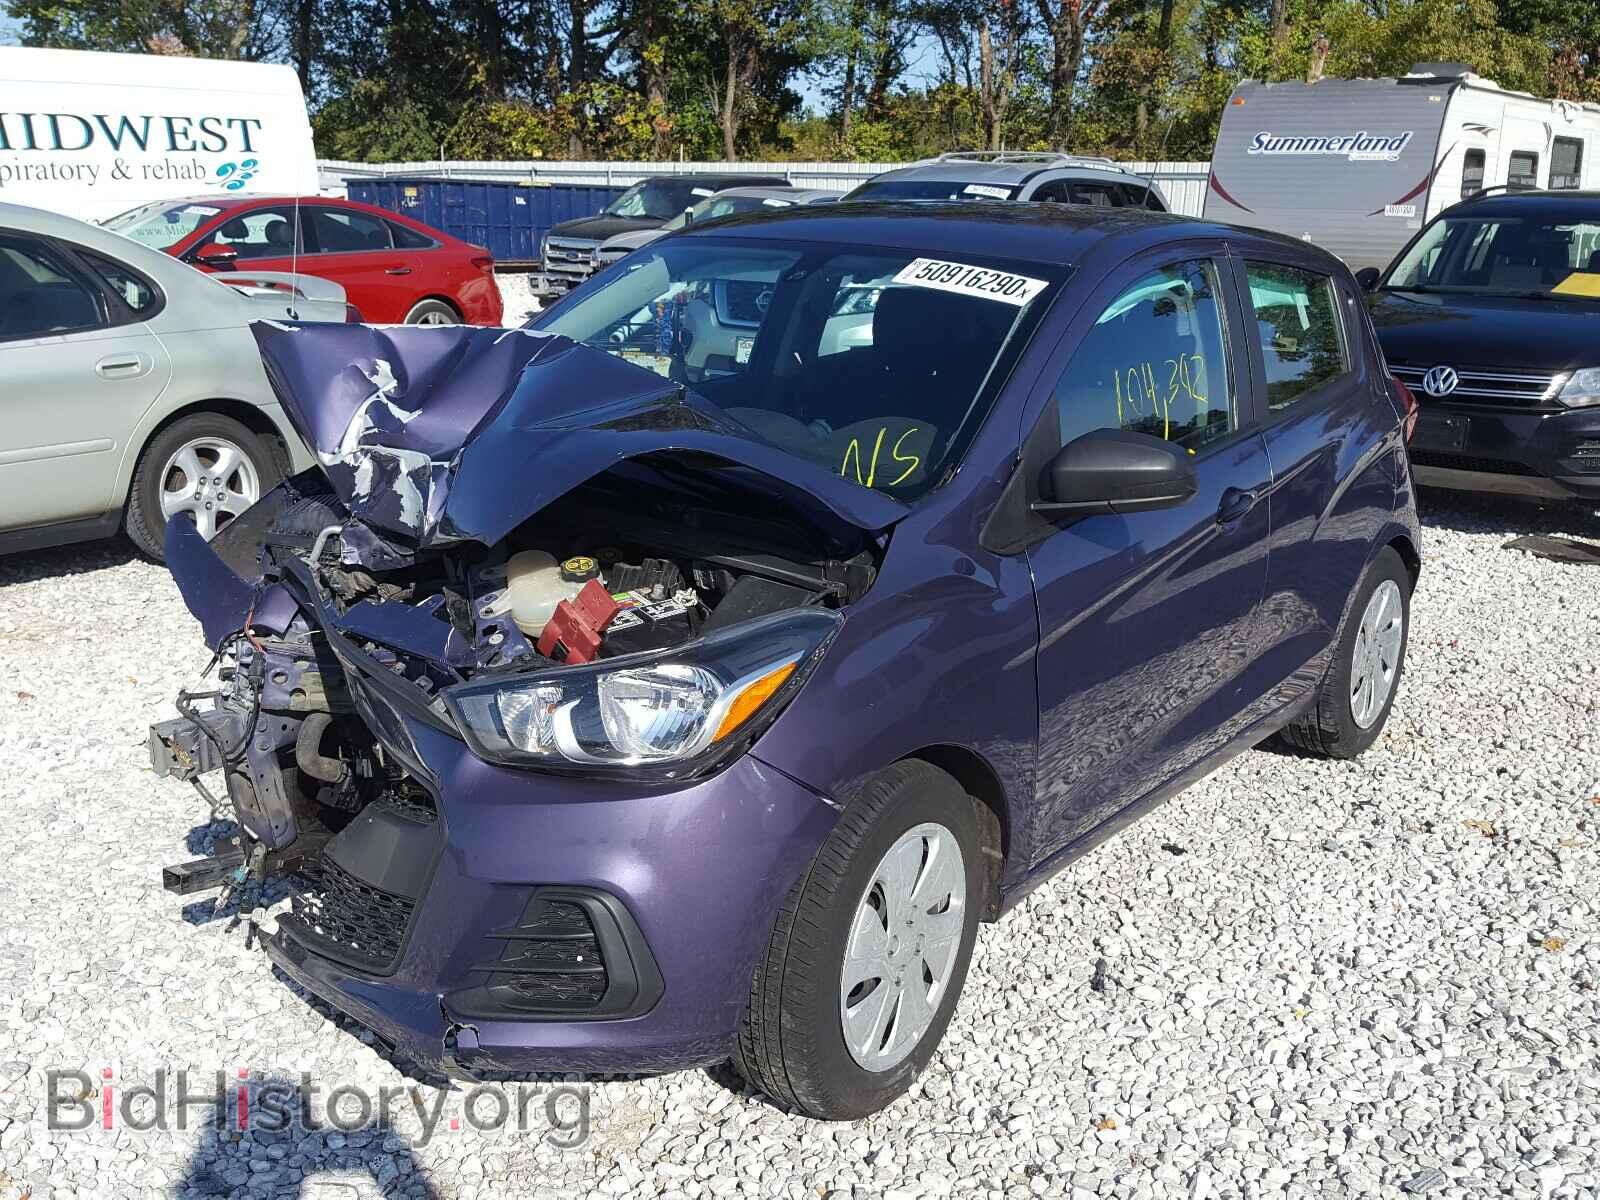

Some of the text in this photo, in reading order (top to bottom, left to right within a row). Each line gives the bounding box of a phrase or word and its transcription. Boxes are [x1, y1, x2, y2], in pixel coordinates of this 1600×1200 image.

[1249, 131, 1412, 152] Summerland
[111, 158, 133, 180] &
[142, 158, 206, 181] rehab
